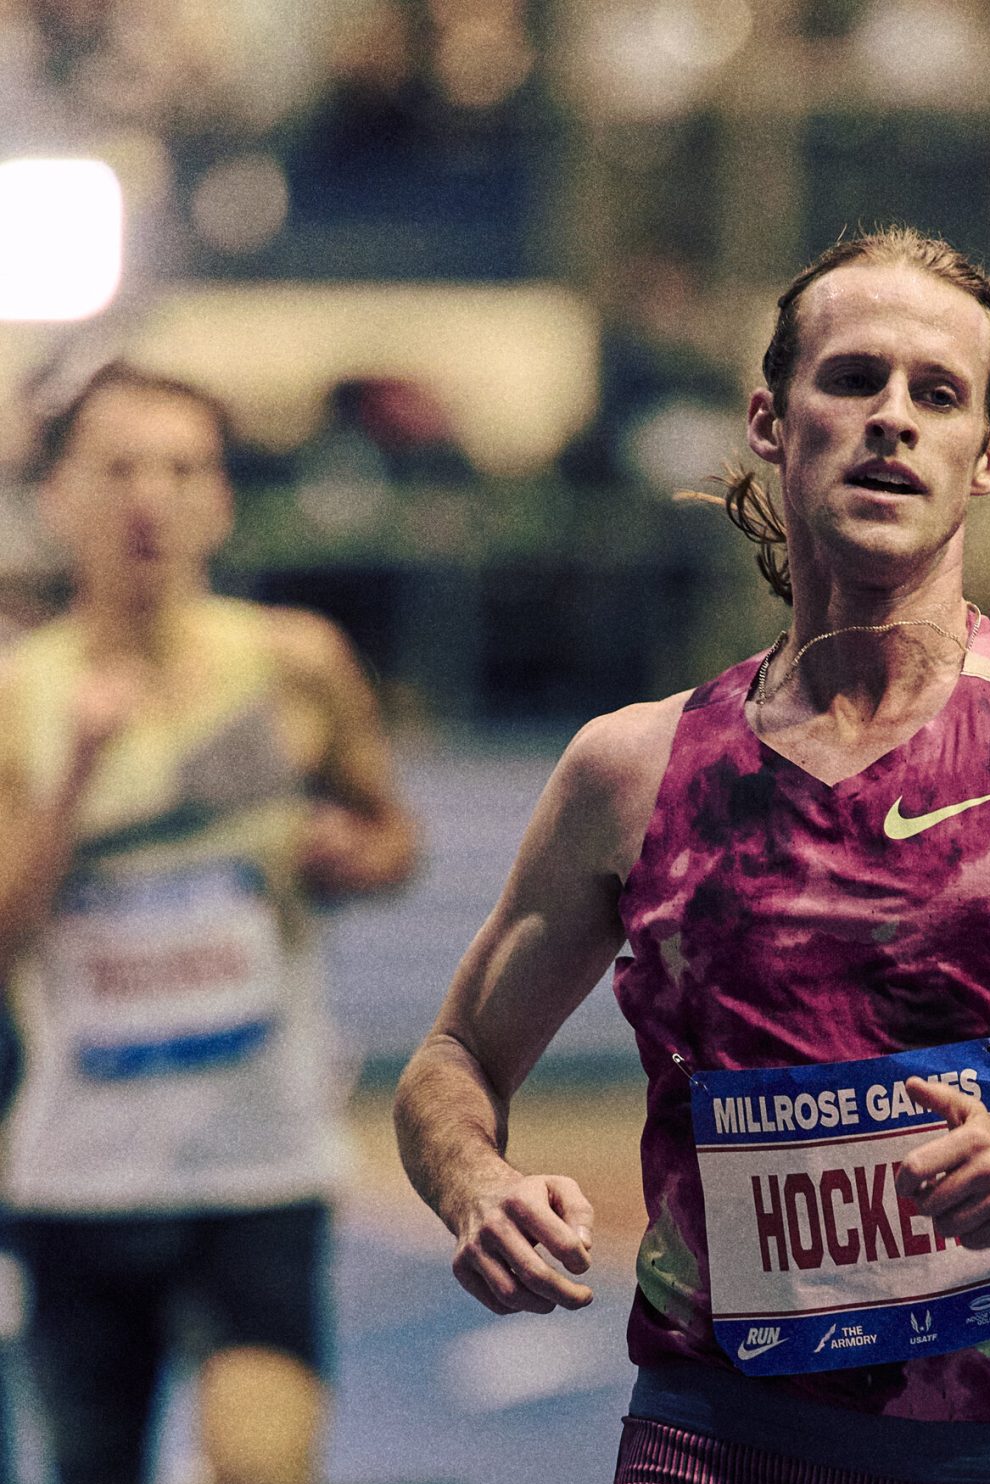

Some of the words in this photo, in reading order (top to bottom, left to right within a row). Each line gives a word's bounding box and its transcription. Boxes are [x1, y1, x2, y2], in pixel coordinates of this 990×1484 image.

[713, 1088, 859, 1134] MILLROSE
[751, 1161, 962, 1272] HOCKE
[746, 1327, 781, 1345] RUN
[842, 1326, 863, 1337] THE
[910, 1333, 938, 1345] USATF
[831, 1334, 878, 1349] ARMORY
